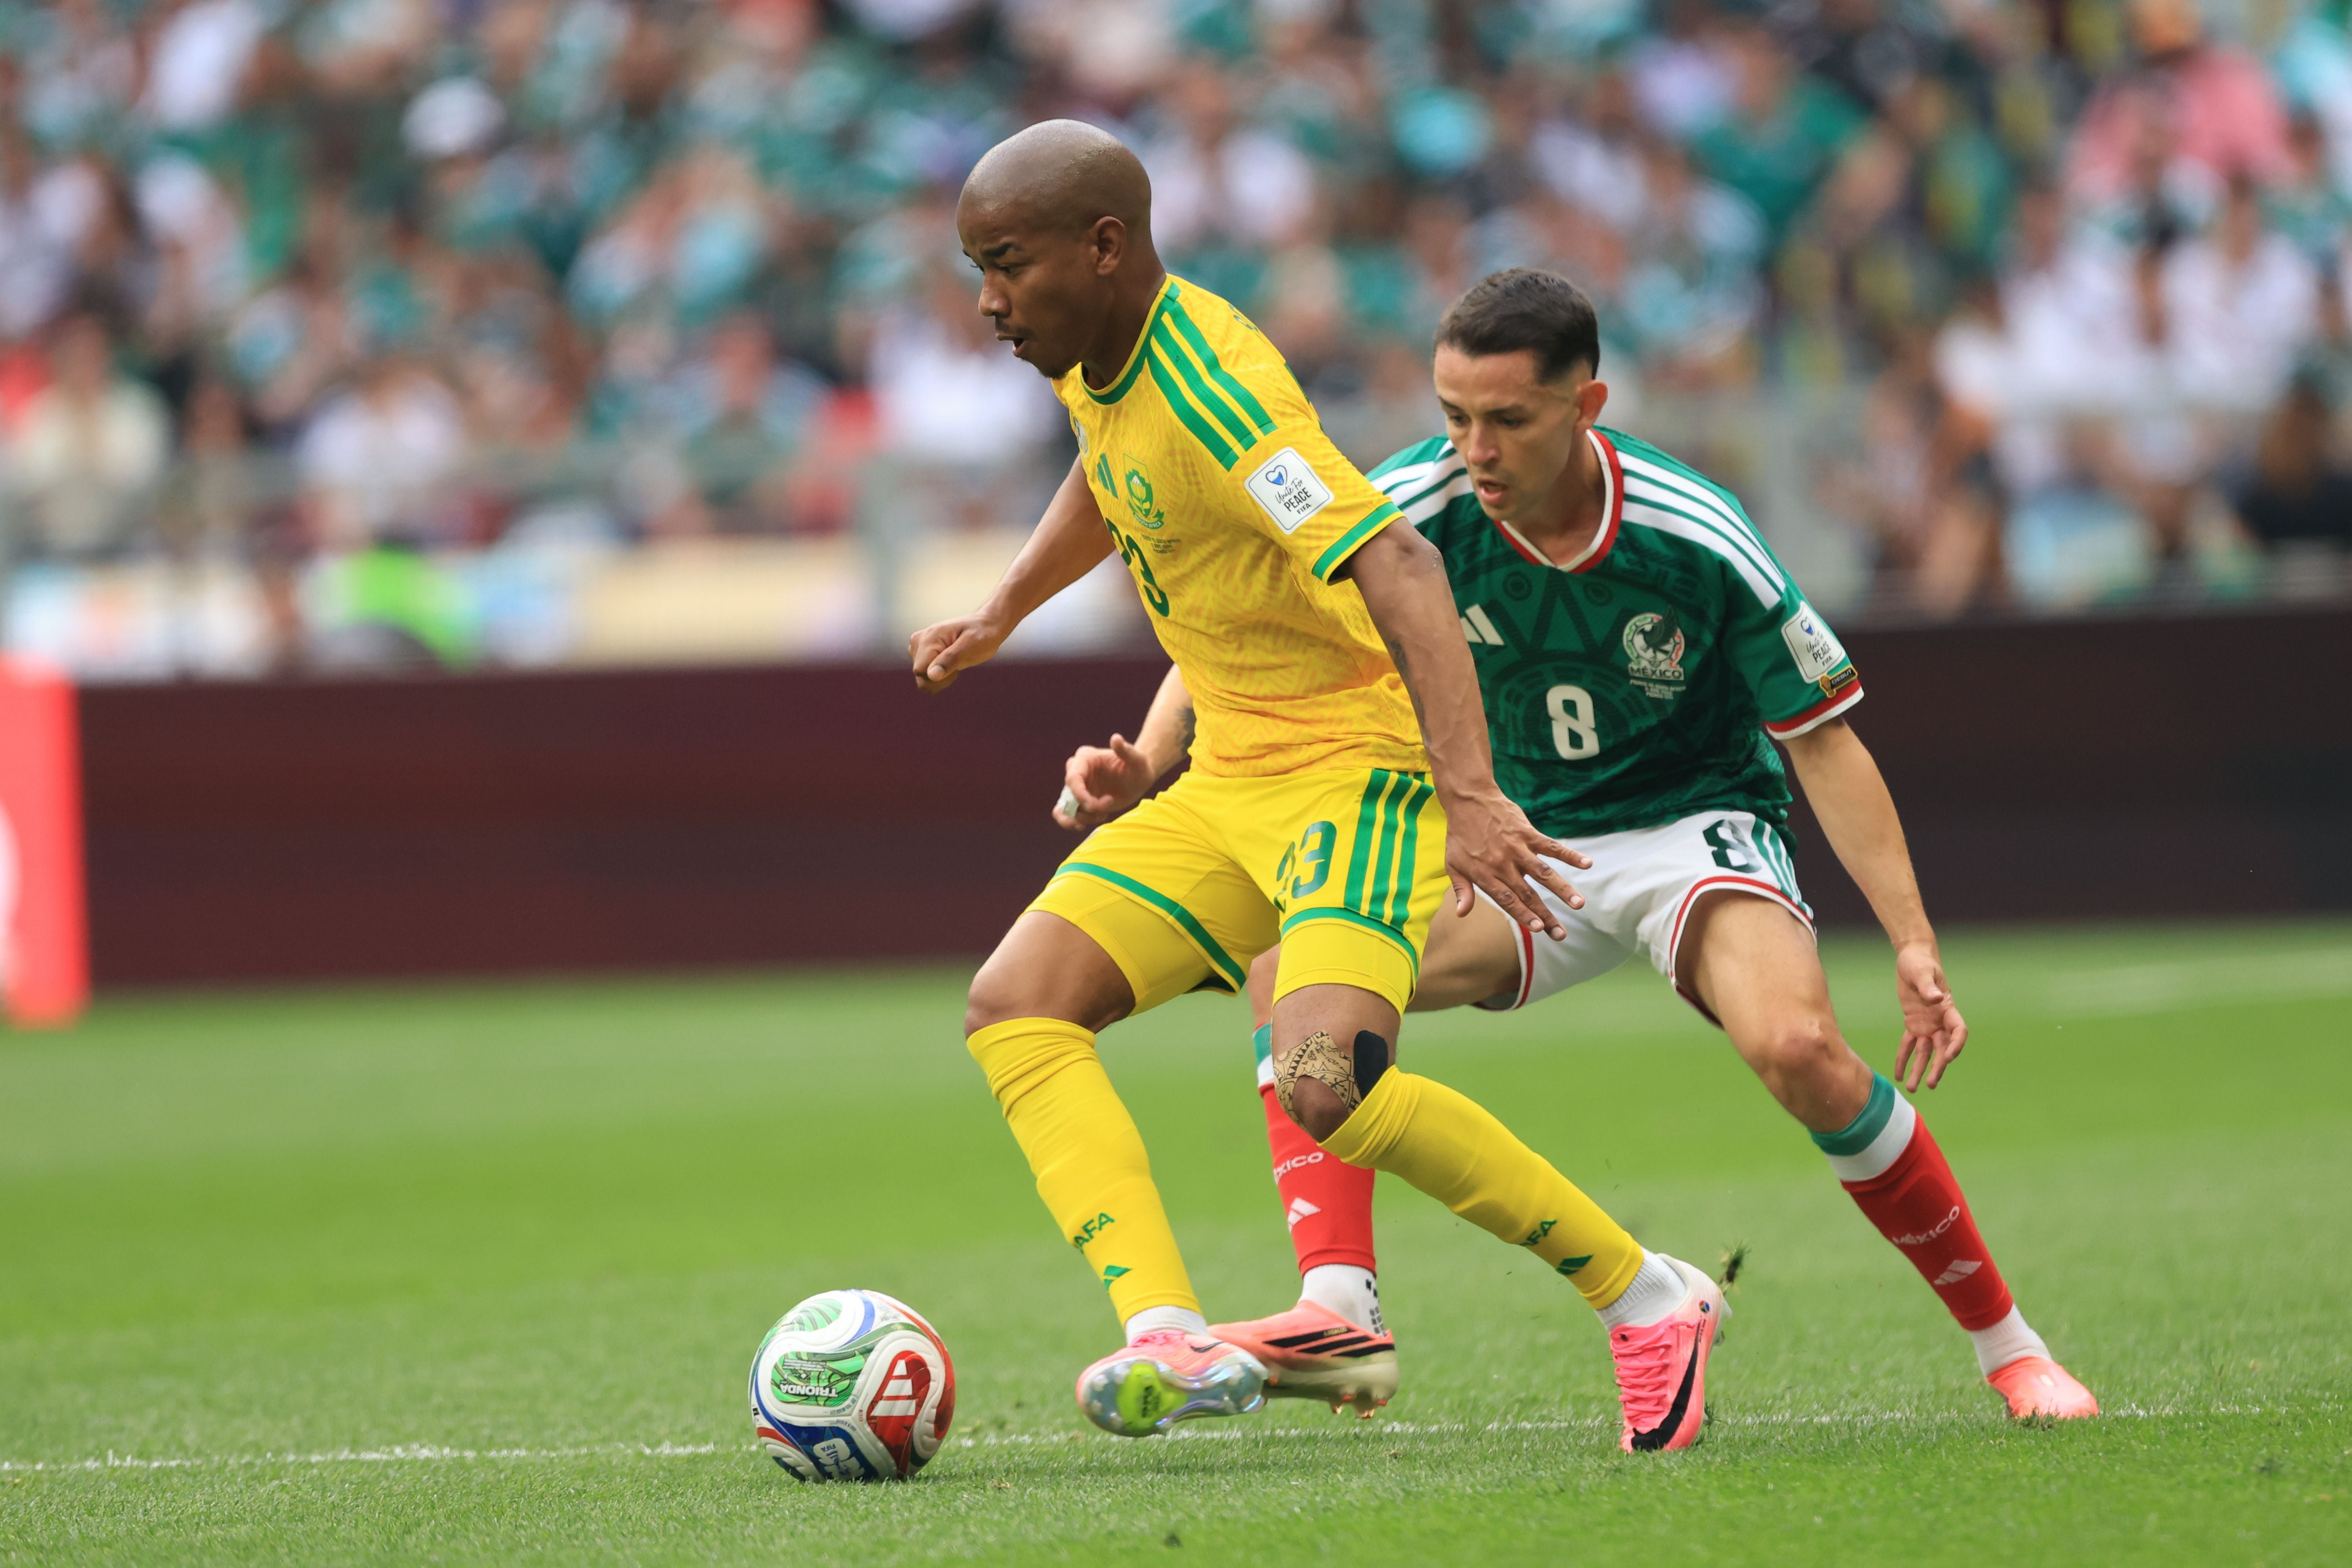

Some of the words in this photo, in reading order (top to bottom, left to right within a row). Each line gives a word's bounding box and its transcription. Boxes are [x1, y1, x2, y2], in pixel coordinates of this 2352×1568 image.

[1275, 486, 1294, 504] Unite
[1291, 478, 1303, 491] For
[1284, 487, 1312, 512] PEACE
[1296, 503, 1311, 514] FIFA
[1813, 642, 1831, 663] PEACE
[1822, 656, 1833, 667] FIFA
[1631, 666, 1682, 679] MÉXICO
[1831, 668, 1852, 684] DEBUT
[1546, 684, 1600, 760] 8
[1702, 819, 1762, 874] 8
[1274, 1151, 1324, 1186] XICO
[1074, 1212, 1115, 1254] AFA
[780, 1384, 838, 1397] TRIONDA
[821, 1444, 836, 1452] FIFA
